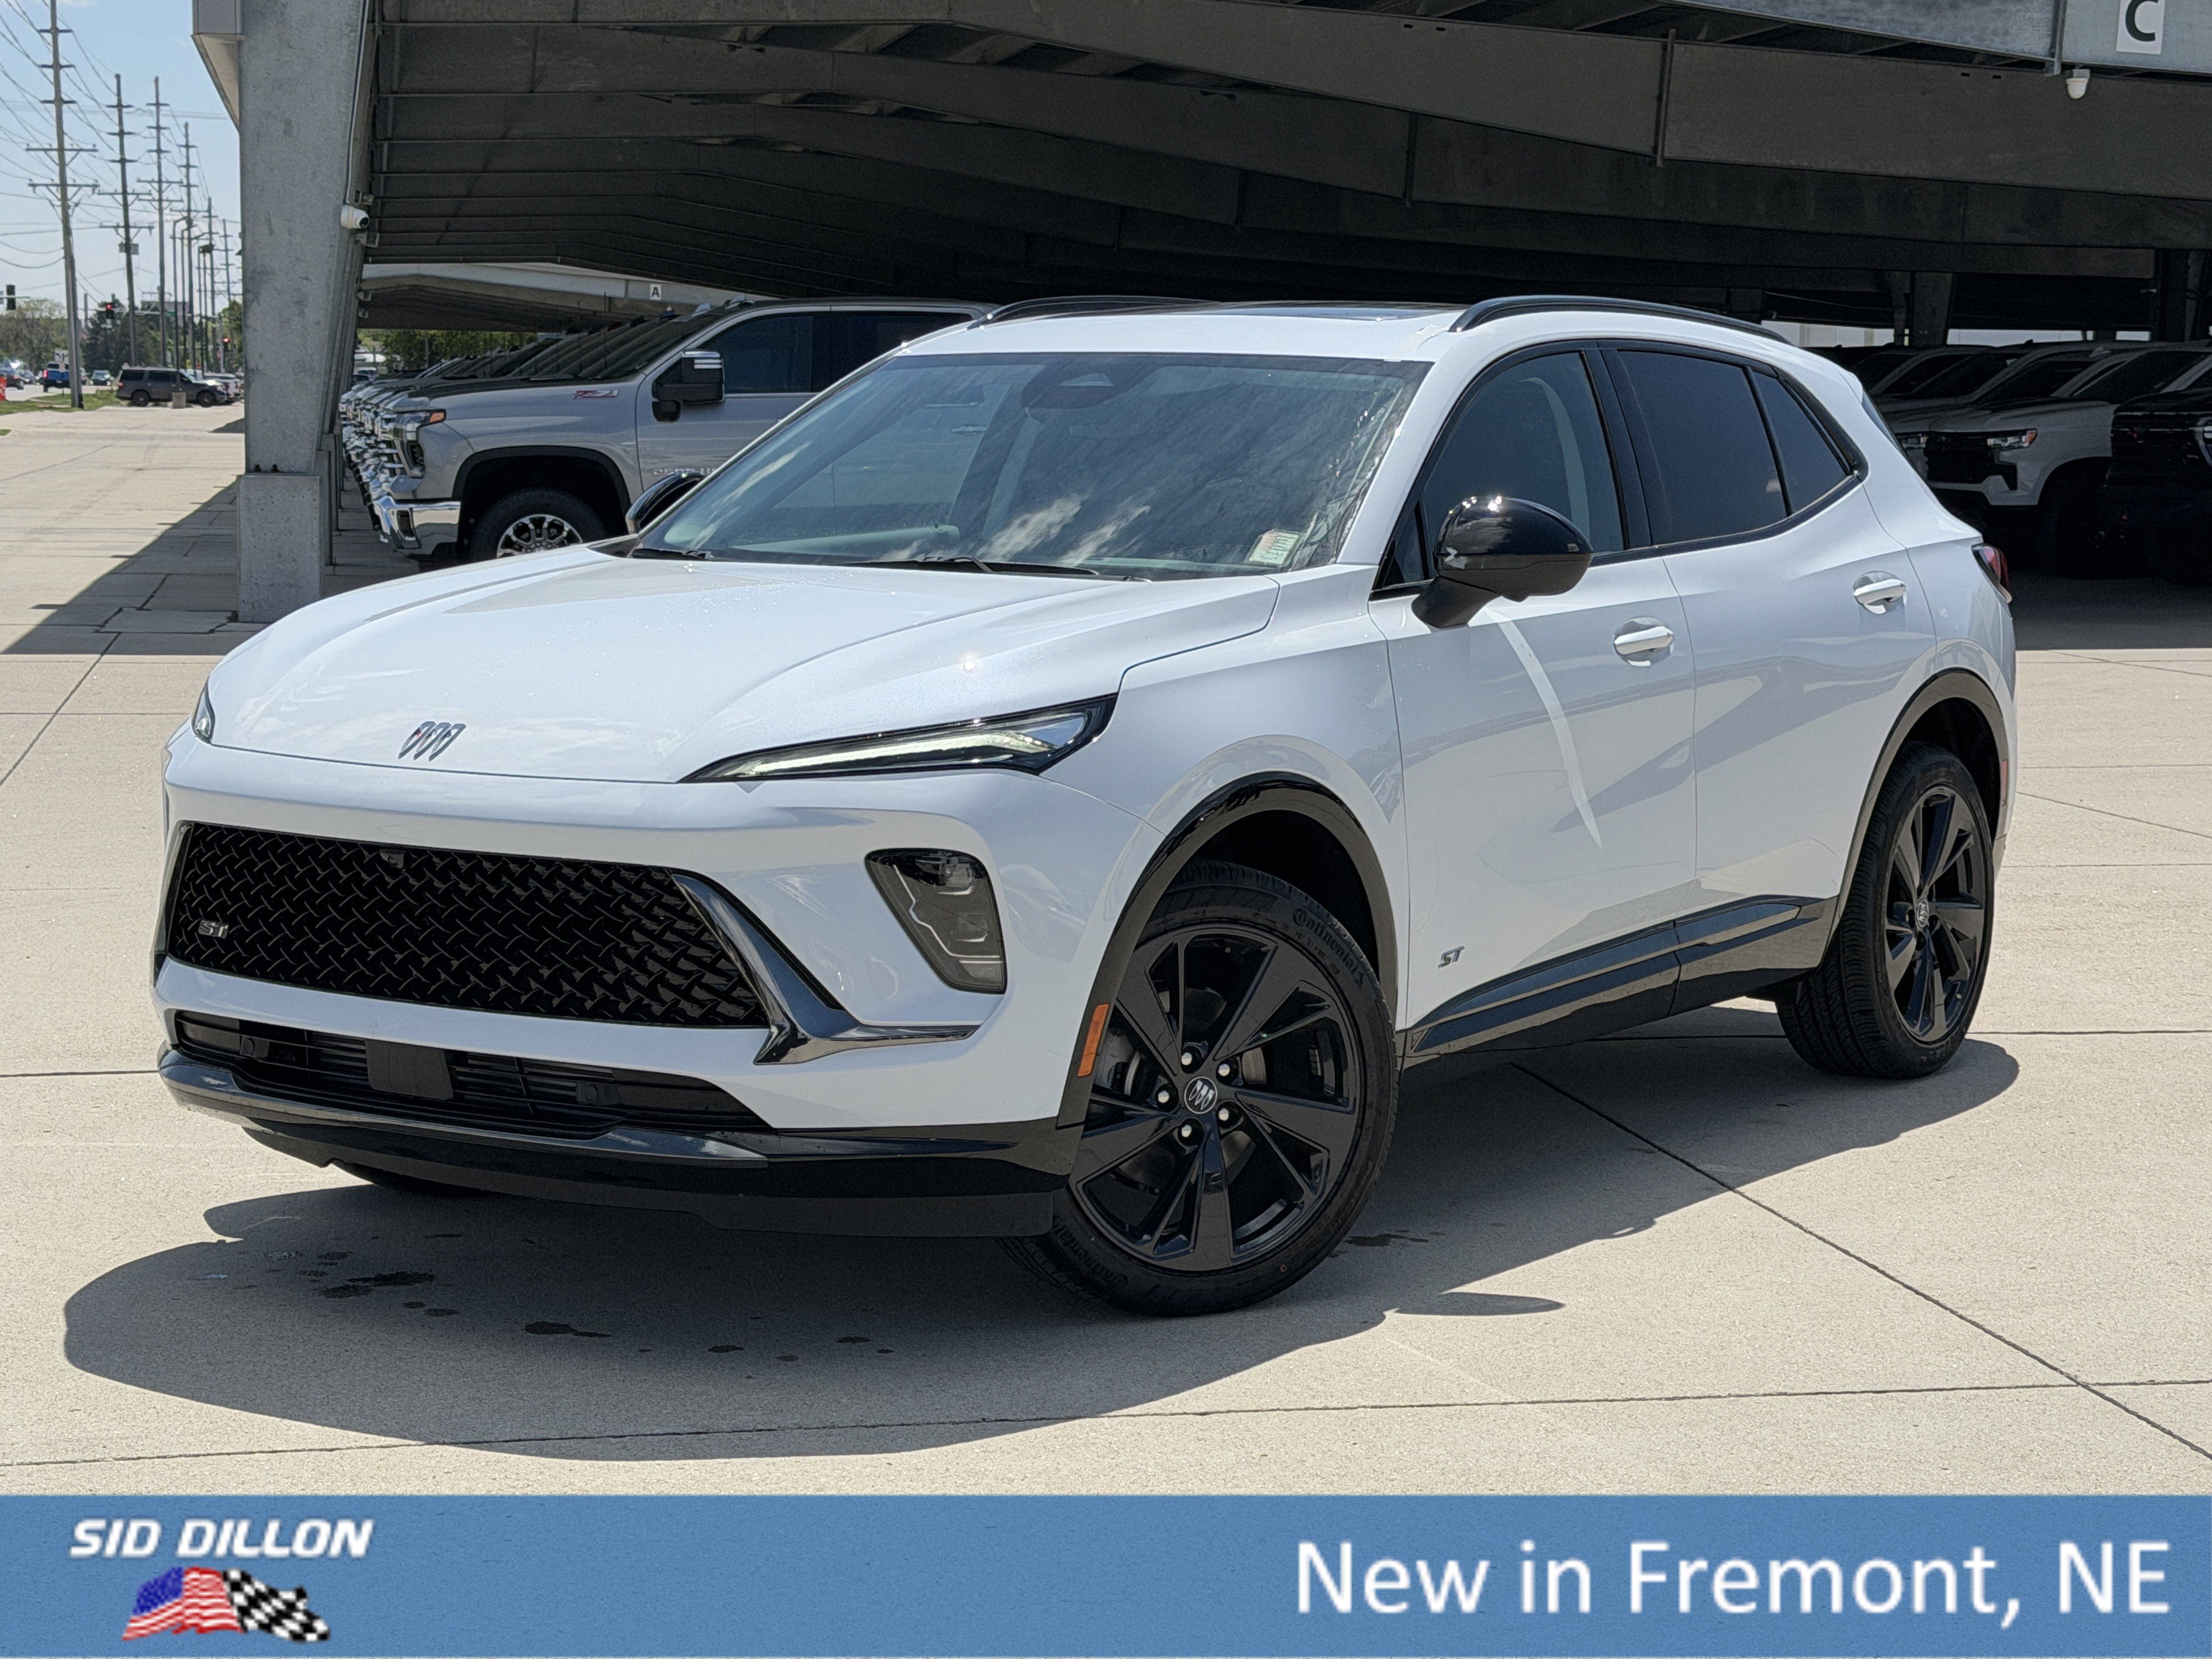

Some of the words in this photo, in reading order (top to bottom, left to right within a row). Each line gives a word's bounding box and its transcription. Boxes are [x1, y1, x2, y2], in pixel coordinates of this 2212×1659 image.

[2125, 0, 2159, 42] C
[651, 286, 660, 297] A
[198, 919, 229, 939] ST
[1292, 907, 1360, 975] Continental
[1438, 946, 1465, 969] ST
